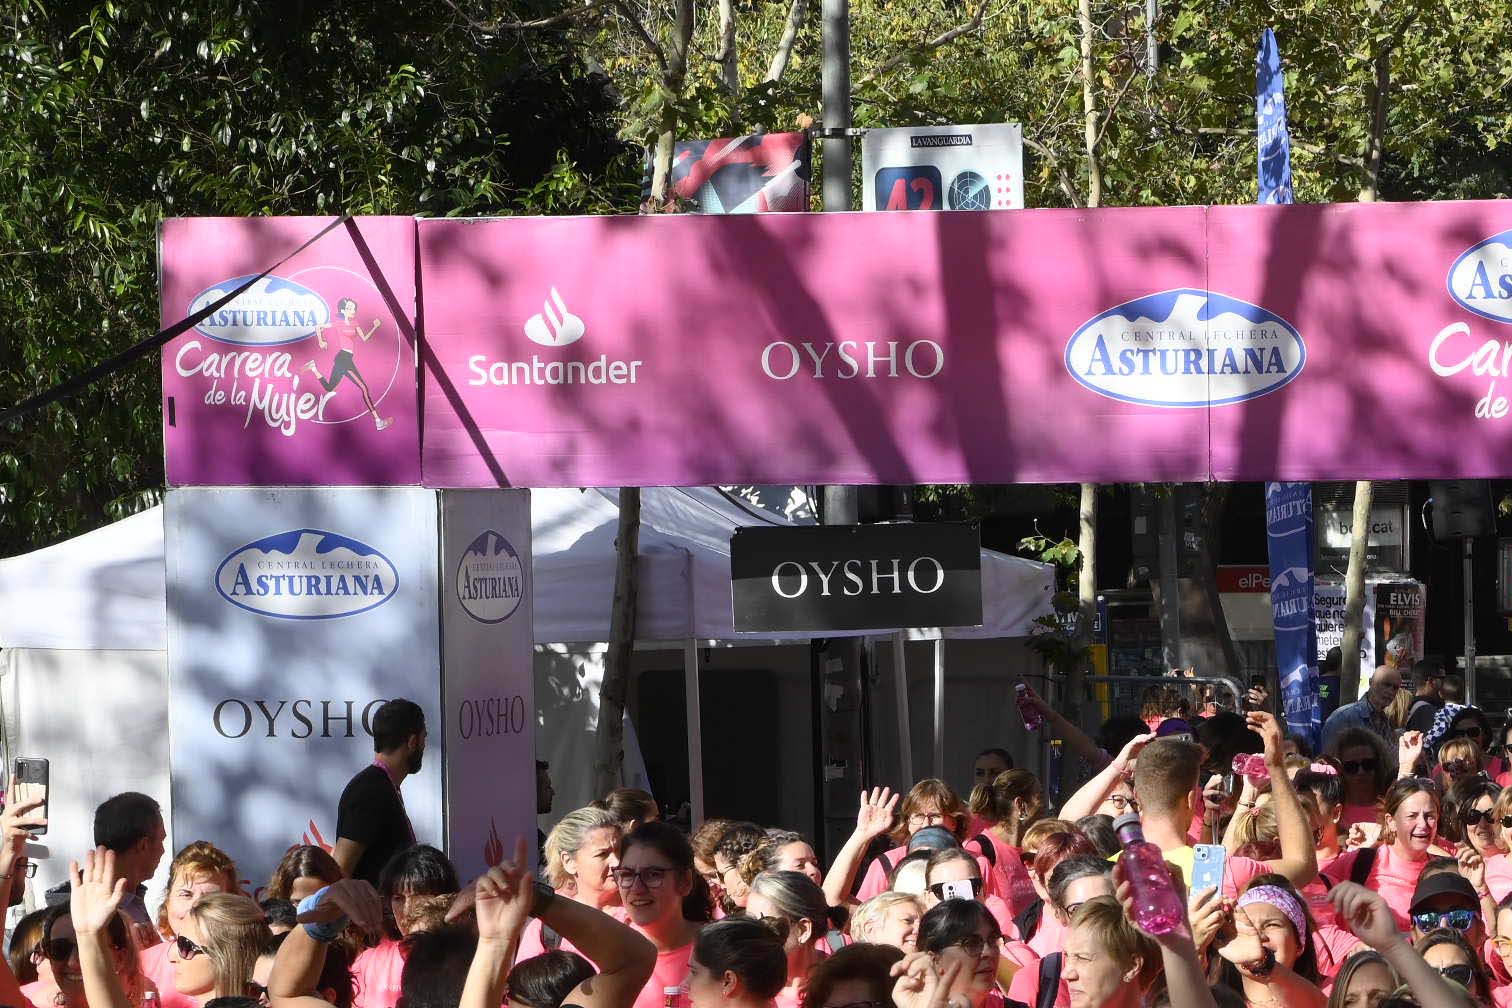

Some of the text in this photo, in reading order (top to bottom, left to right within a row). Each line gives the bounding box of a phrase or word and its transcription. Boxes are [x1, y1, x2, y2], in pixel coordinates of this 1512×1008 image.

[1121, 328, 1280, 343] CENTRAL LECHERA
[175, 340, 293, 378] Carrera
[468, 354, 642, 386] Santander
[761, 339, 945, 380] OYSHO
[1086, 334, 1288, 377] ASTURIANA
[204, 375, 336, 437] de la Mujer
[1474, 379, 1510, 419] de
[230, 562, 386, 596] ASTURIANA
[257, 560, 380, 570] CENTRAL LECHERA
[771, 556, 945, 599] OYSHO
[1238, 573, 1271, 590] elPe
[461, 566, 520, 601] ASTURIANA
[1390, 592, 1421, 605] ELVIS
[1315, 621, 1345, 633] quiere
[459, 694, 525, 740] OYSHO
